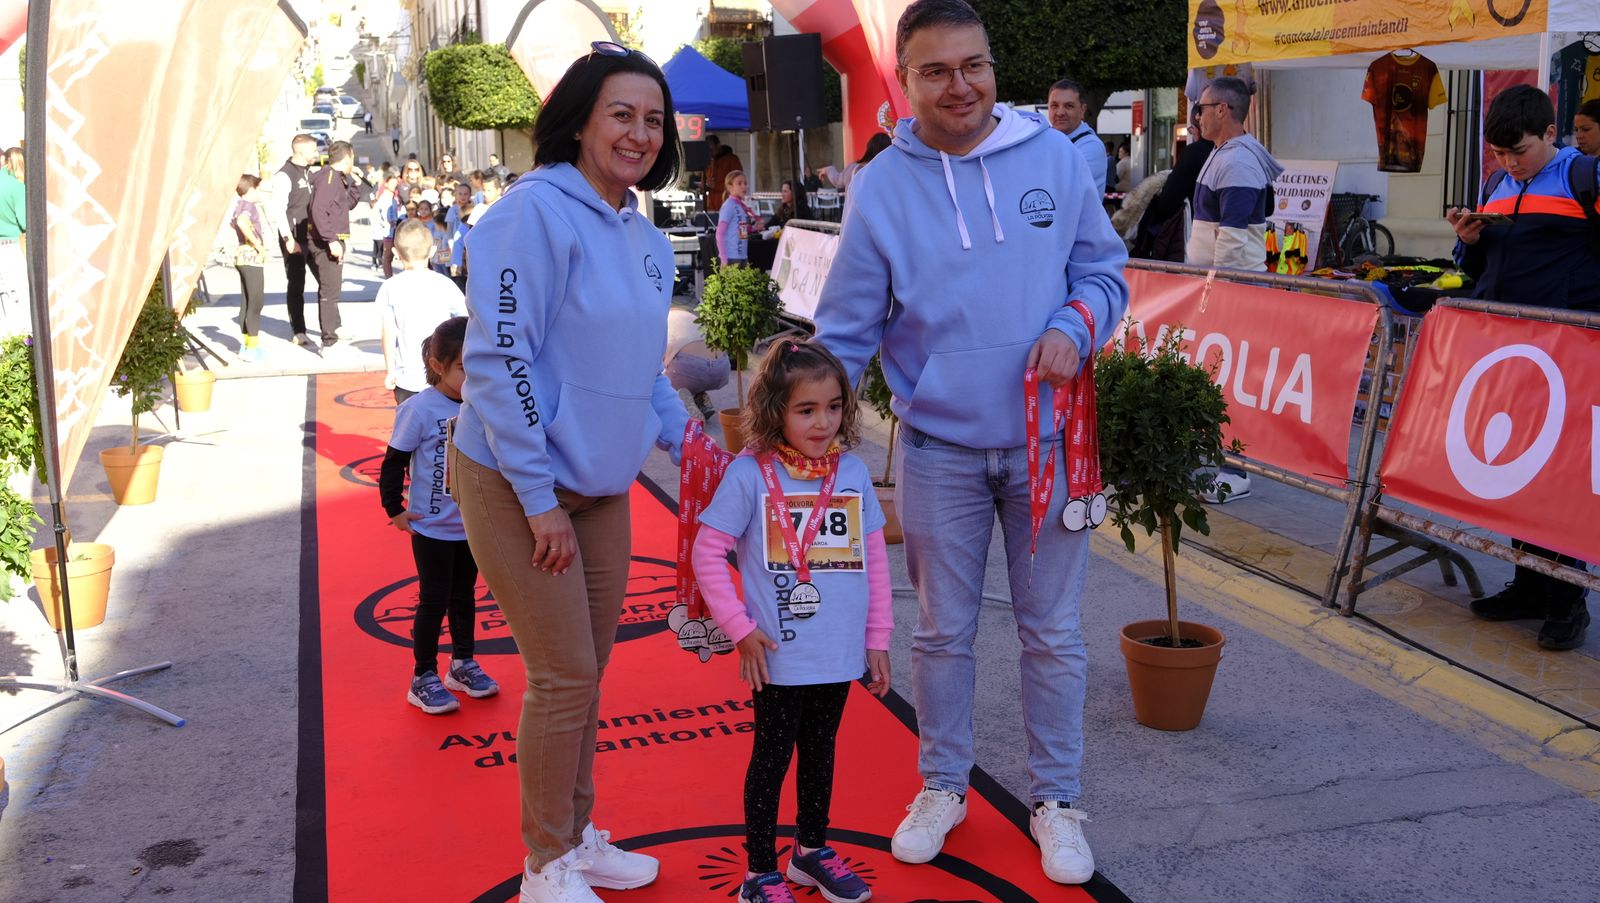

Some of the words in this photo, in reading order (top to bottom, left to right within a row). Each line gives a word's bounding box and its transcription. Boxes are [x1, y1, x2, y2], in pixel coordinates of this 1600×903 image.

[1274, 17, 1409, 45] #contralaleucemiainfantil
[1279, 174, 1329, 185] ALCETINES
[1273, 187, 1326, 198] SOLIDARIOS
[496, 321, 516, 348] LA
[437, 418, 447, 435] LA
[595, 720, 756, 753] antoria
